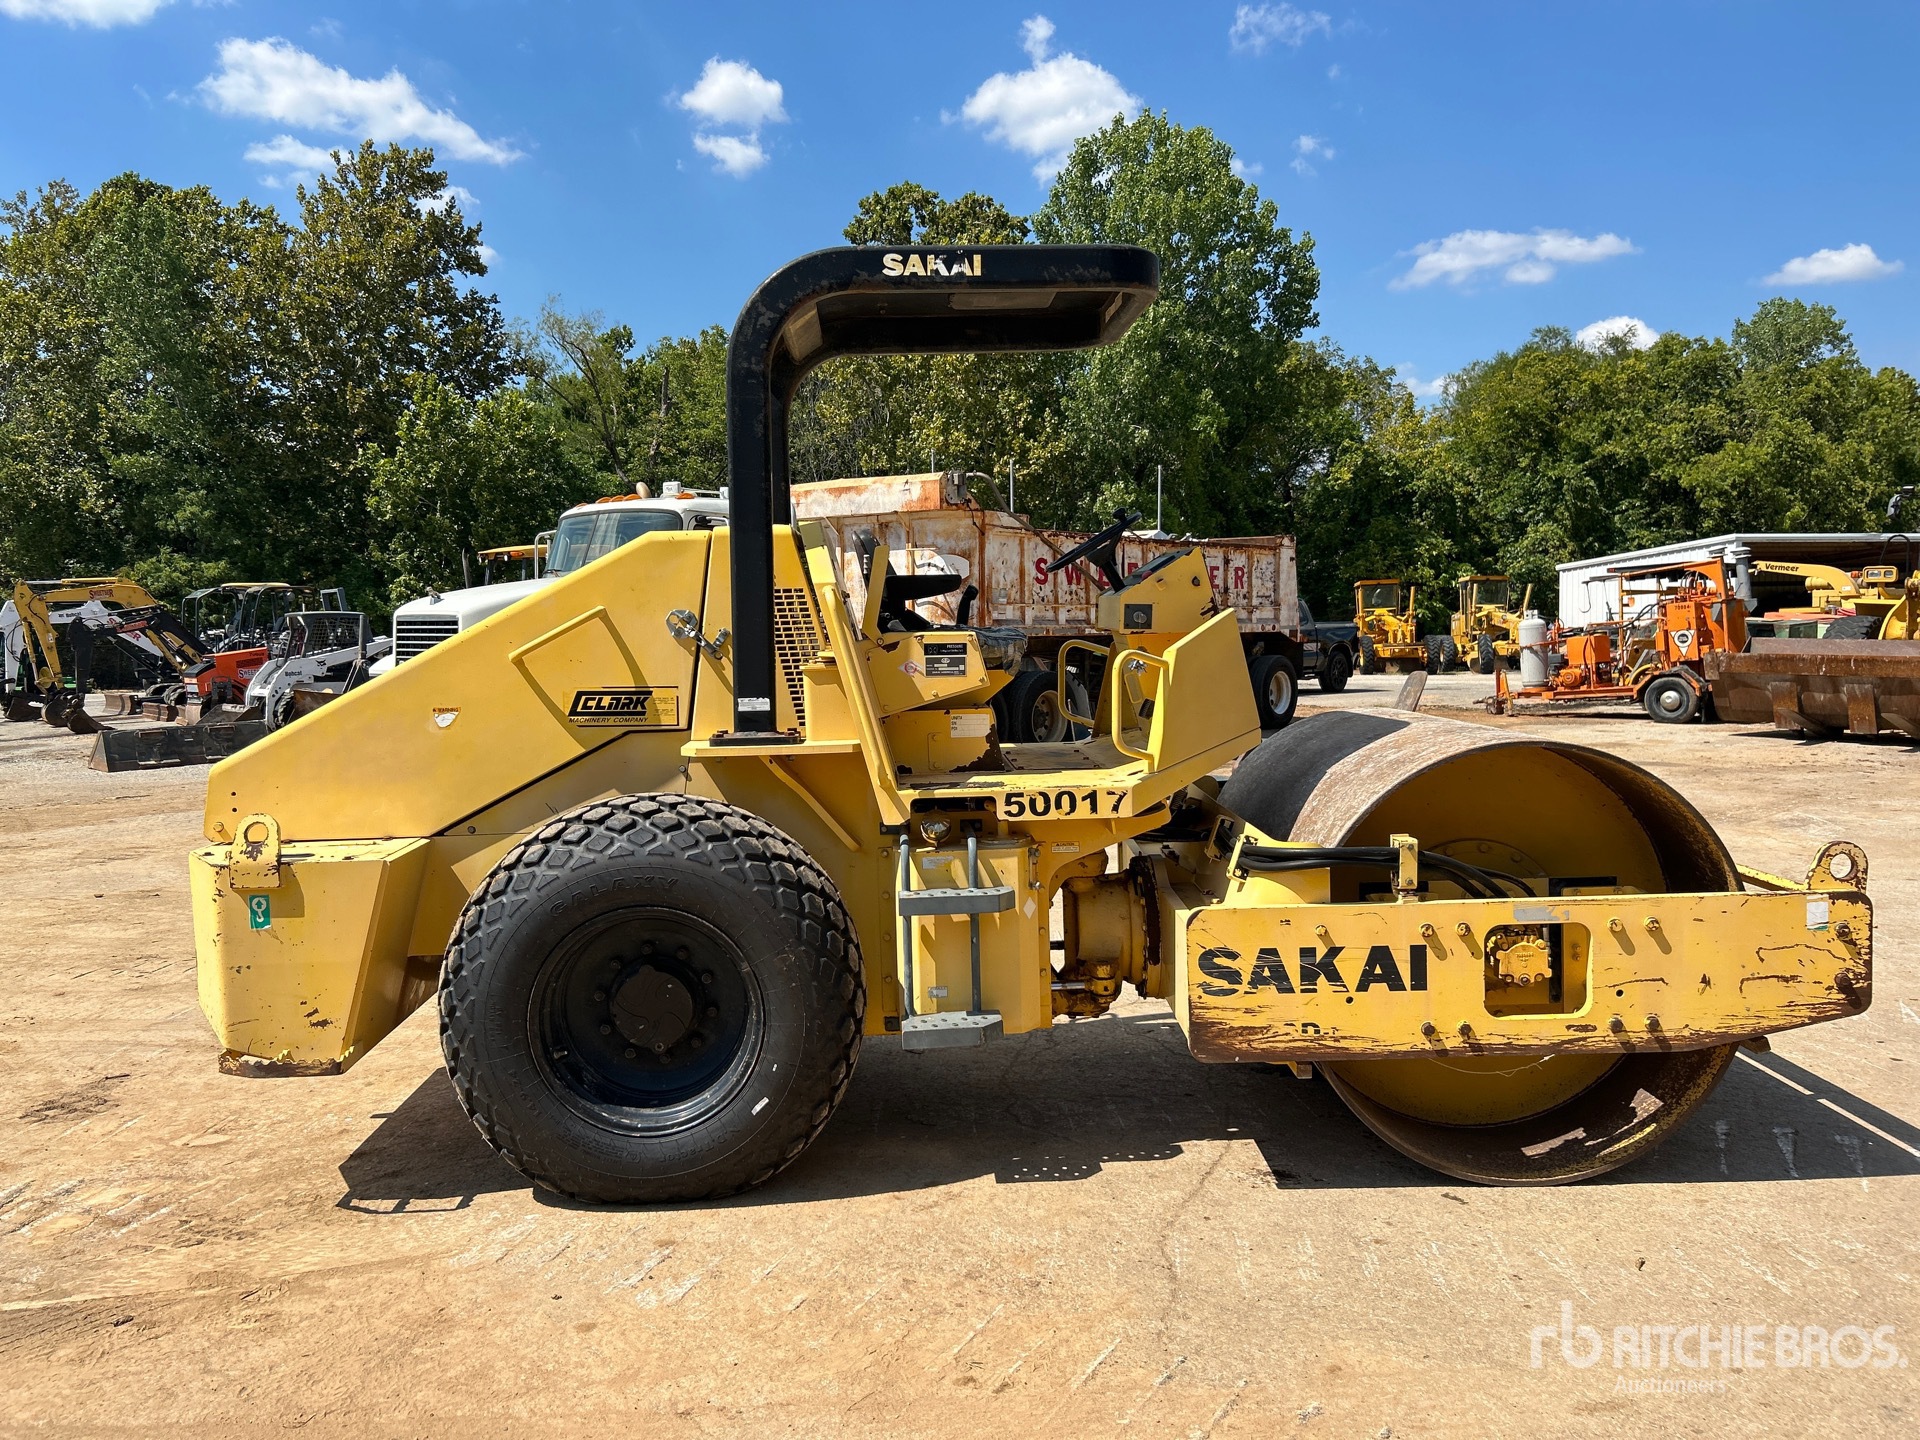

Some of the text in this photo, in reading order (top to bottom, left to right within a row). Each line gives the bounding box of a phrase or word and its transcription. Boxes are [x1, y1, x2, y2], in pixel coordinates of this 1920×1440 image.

[882, 253, 982, 276] SAKAI
[1765, 563, 1799, 572] Vermeer
[580, 696, 651, 711] CLARK
[1004, 789, 1128, 817] 50017
[549, 874, 680, 916] GALAXY
[1198, 944, 1428, 997] SAKAI
